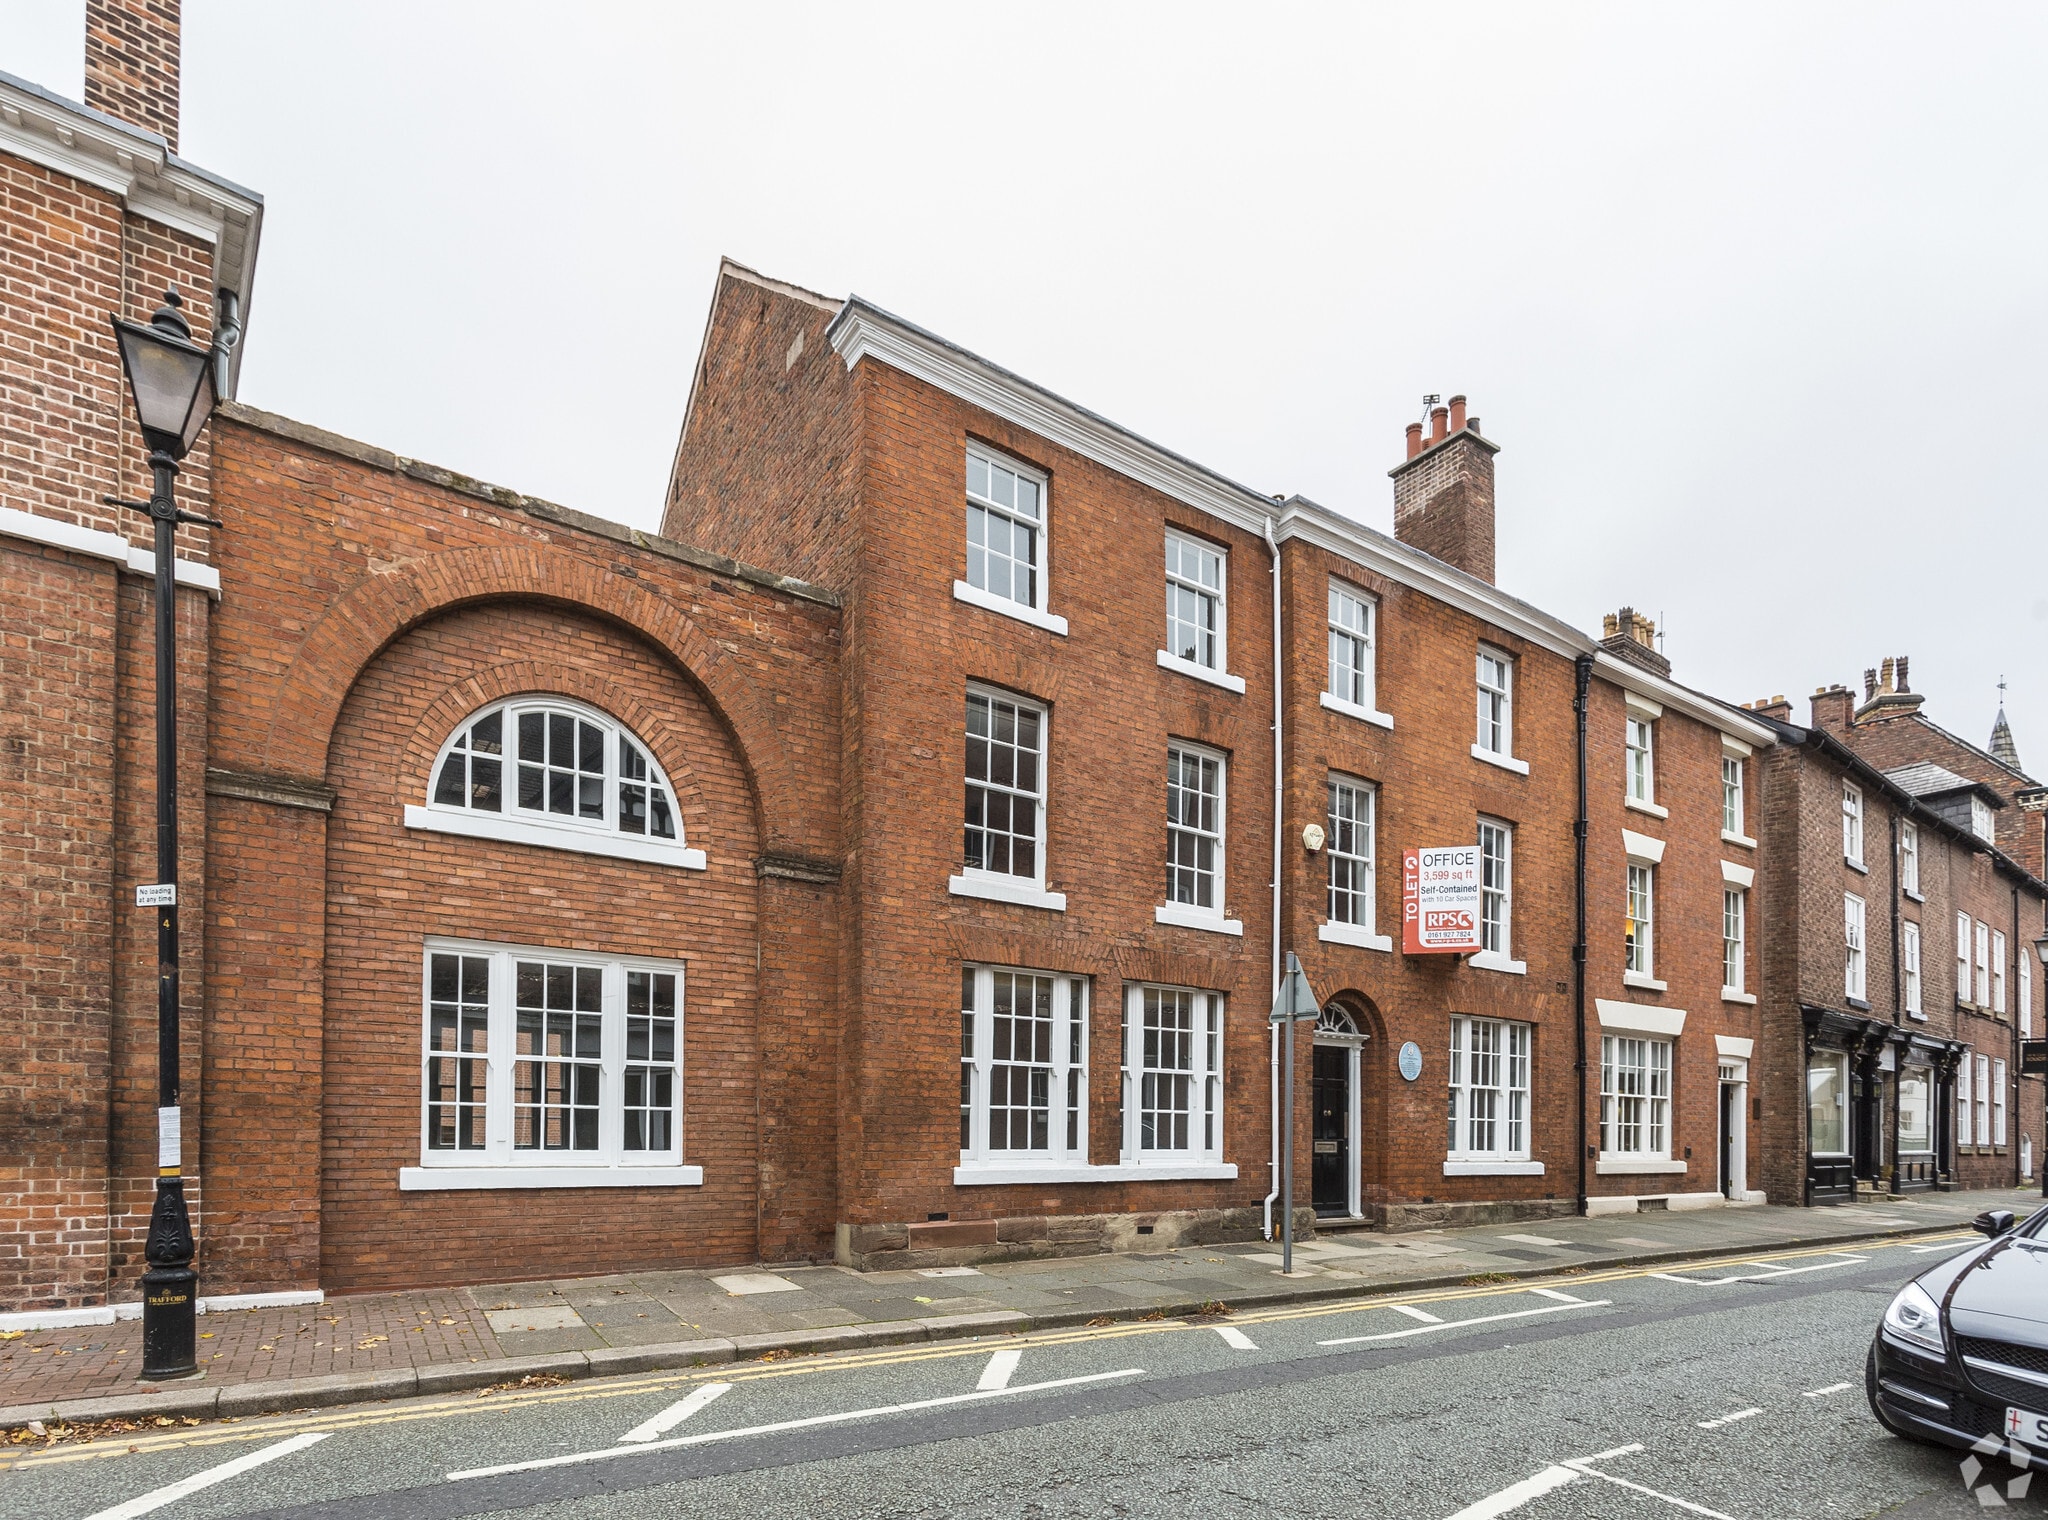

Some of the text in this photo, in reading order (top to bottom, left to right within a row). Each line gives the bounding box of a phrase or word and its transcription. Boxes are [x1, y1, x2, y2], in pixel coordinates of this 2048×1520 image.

[1423, 852, 1474, 867] OFFICE
[1424, 869, 1472, 882] 3,599 sq ft
[1420, 884, 1478, 894] Self-Contained
[1406, 872, 1418, 922] TO LET
[163, 919, 170, 928] 4
[1428, 912, 1457, 927] RPS
[148, 1294, 187, 1303] TRAFFORD
